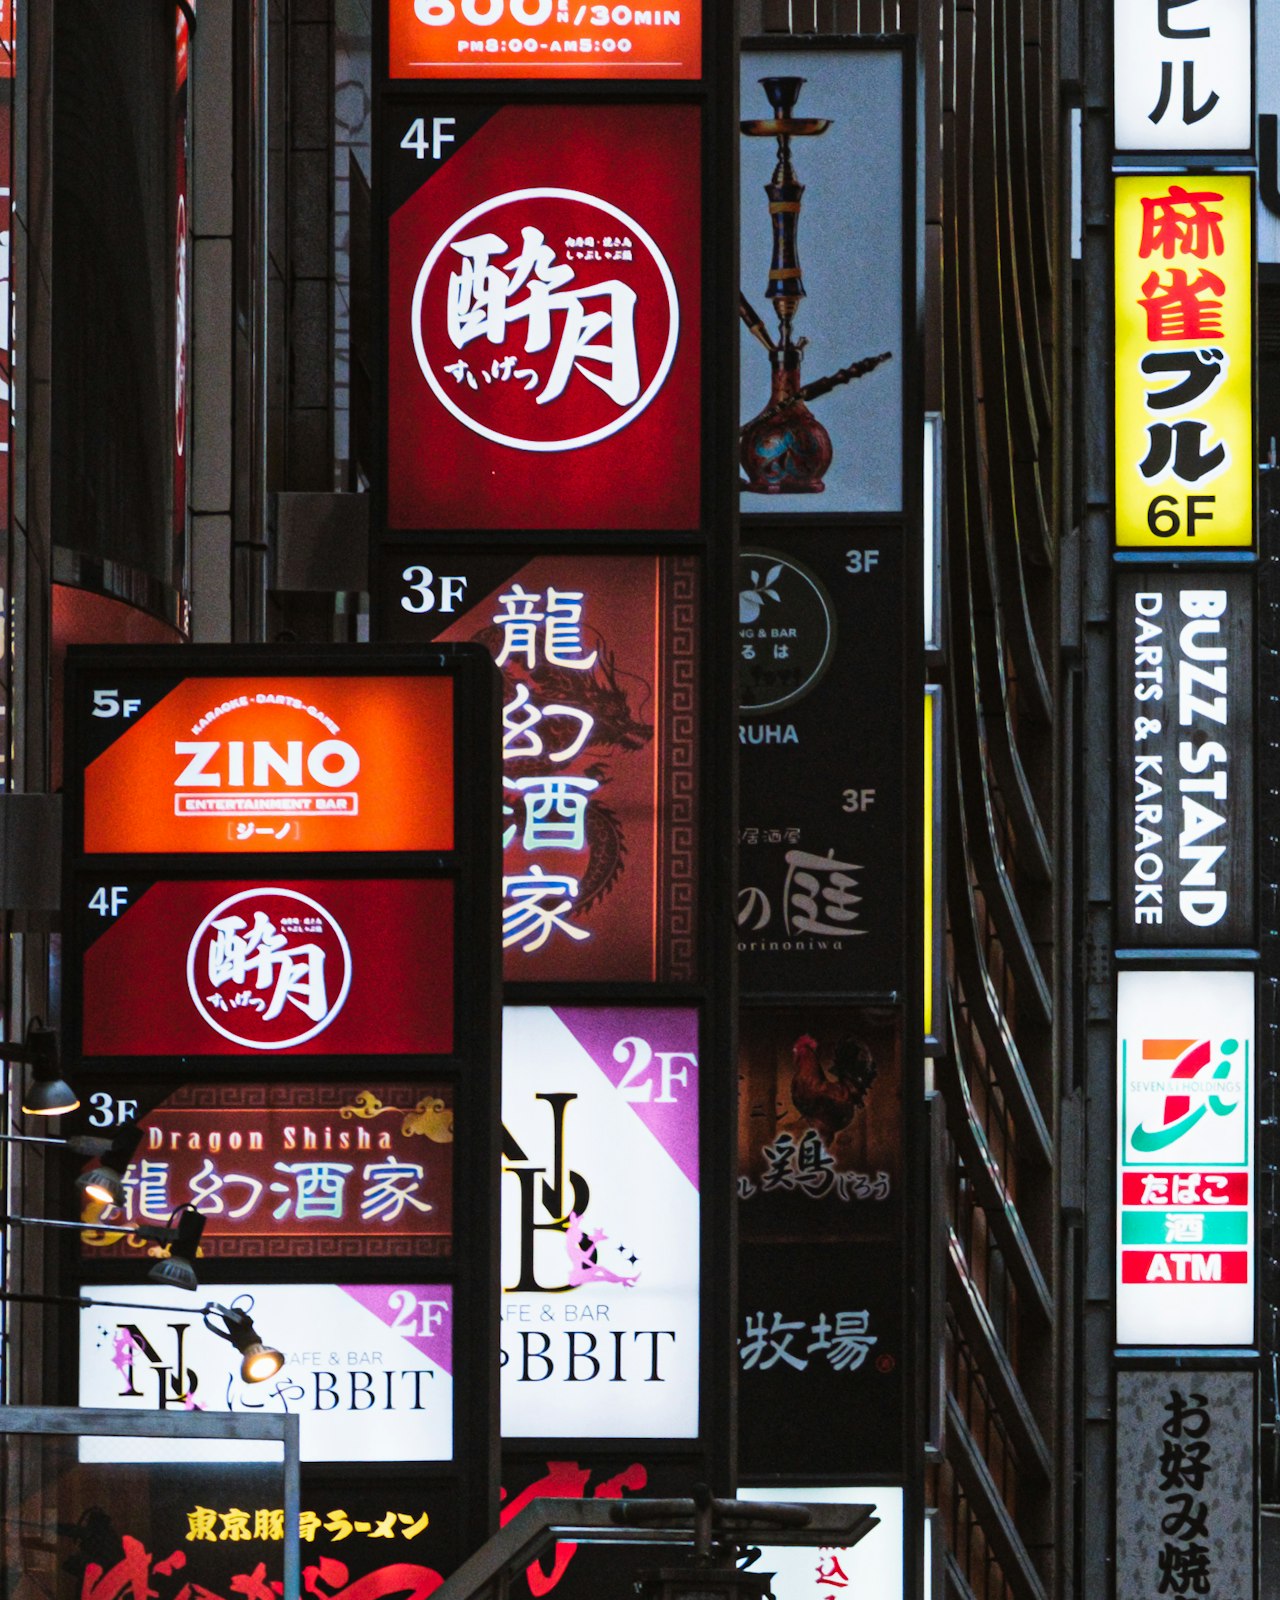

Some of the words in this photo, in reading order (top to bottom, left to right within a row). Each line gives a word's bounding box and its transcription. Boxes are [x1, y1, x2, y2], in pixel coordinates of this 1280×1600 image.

[400, 117, 456, 160] 4F
[447, 226, 638, 407] 酔月
[1137, 185, 1228, 484] 麻雀ブル
[1147, 494, 1216, 539] 6F
[845, 550, 880, 573] 3F
[400, 564, 468, 614] 3F
[770, 628, 797, 638] BAR
[1134, 592, 1163, 701] DARTS
[1178, 589, 1228, 726] BUZZ
[91, 689, 141, 719] 5F
[1134, 716, 1162, 742] &
[173, 739, 361, 788] ZINO
[493, 583, 600, 953] 龍幻酒家
[315, 798, 348, 811] BAR
[842, 789, 876, 812] 3F
[1134, 755, 1163, 925] KARAOKE
[1178, 741, 1228, 927] STAND
[88, 886, 129, 917] 4F
[612, 1035, 699, 1104] 2F
[88, 1092, 139, 1128] 3F
[148, 1126, 264, 1153] Dragon
[283, 1126, 392, 1150] Shisha
[100, 1155, 433, 1223] 龍幻酒家
[1141, 1173, 1230, 1205] たばこ
[1164, 1213, 1204, 1243] 酒
[1146, 1254, 1222, 1282] ATM
[387, 1290, 450, 1338] 2F
[539, 1304, 555, 1322] &
[564, 1304, 610, 1322] BAR
[328, 1351, 341, 1366] &
[347, 1351, 383, 1366] BAR
[739, 1309, 878, 1372] 牧場
[185, 1505, 430, 1543] 東京豚骨ラーメン
